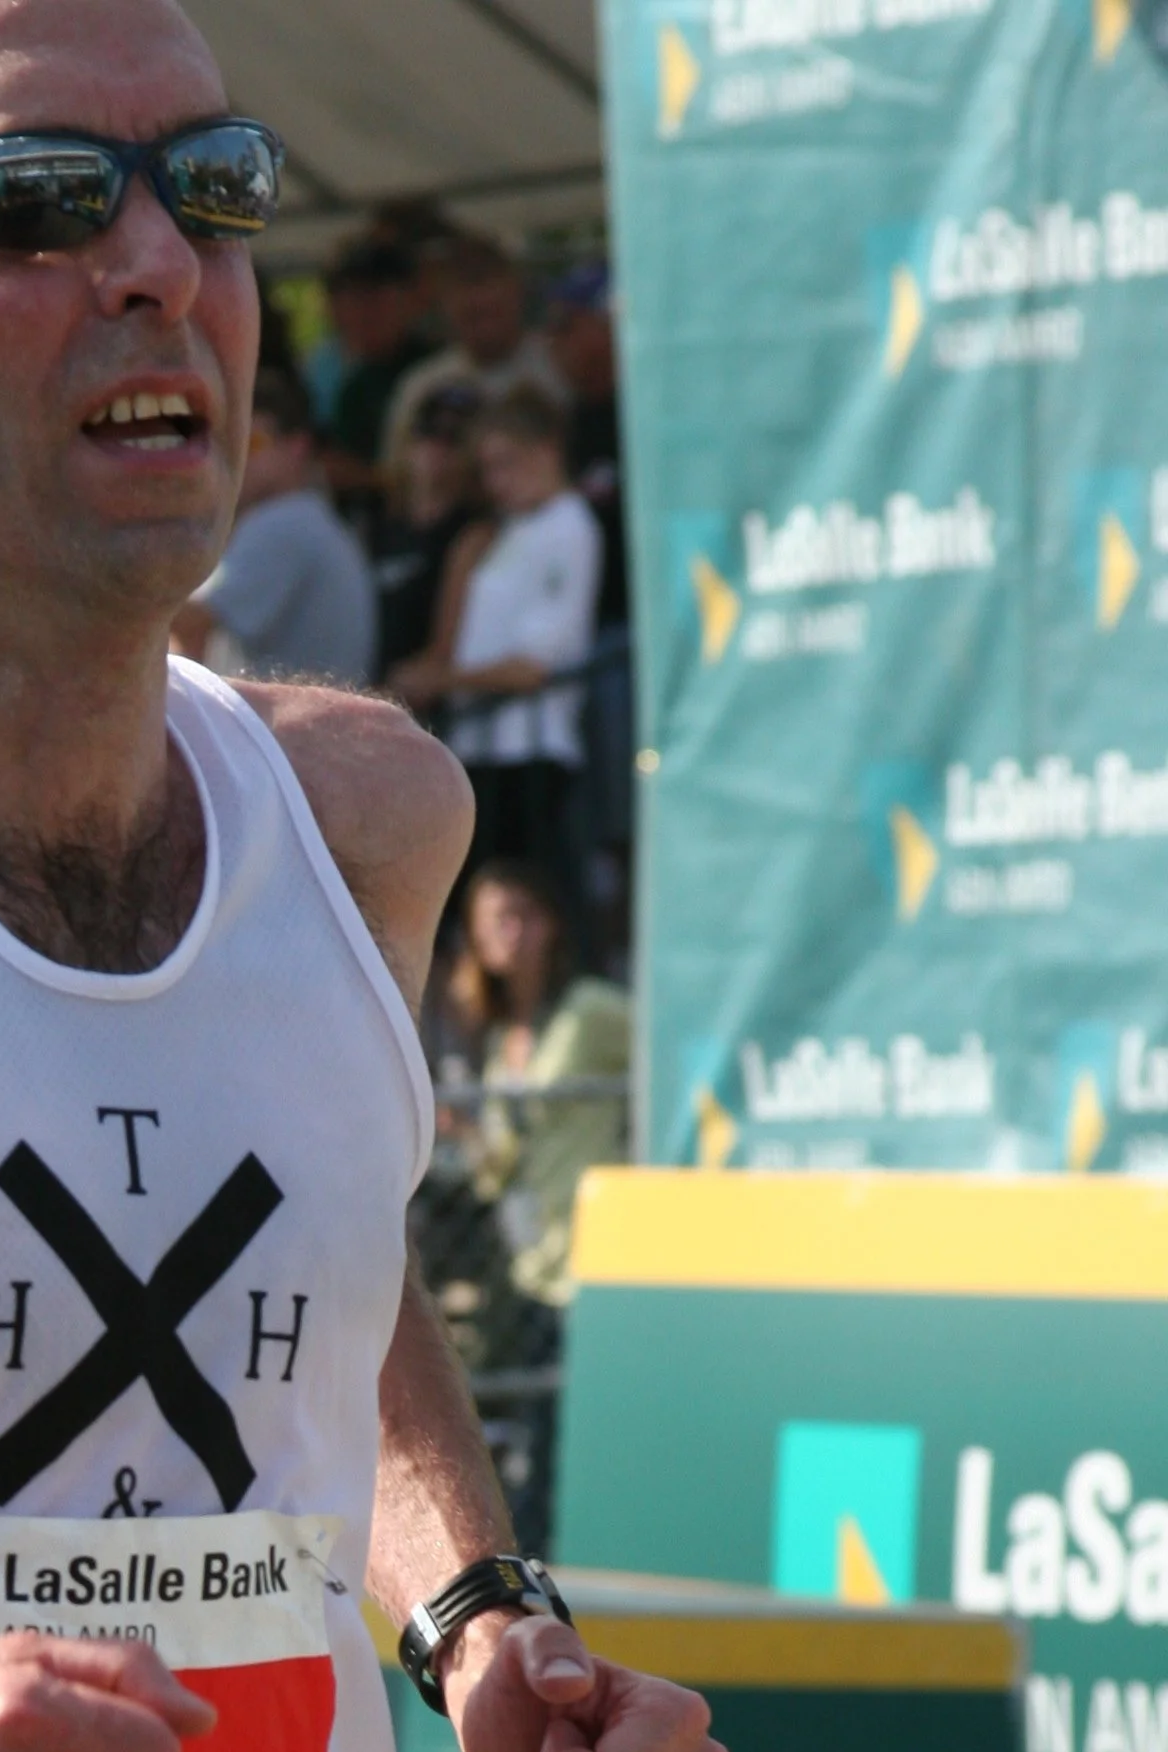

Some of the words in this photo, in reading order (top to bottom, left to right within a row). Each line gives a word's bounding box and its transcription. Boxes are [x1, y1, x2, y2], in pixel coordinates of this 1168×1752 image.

[96, 1106, 160, 1196] T
[245, 1290, 309, 1382] H
[4, 1552, 185, 1606] LaSalle
[200, 1544, 290, 1601] Bank
